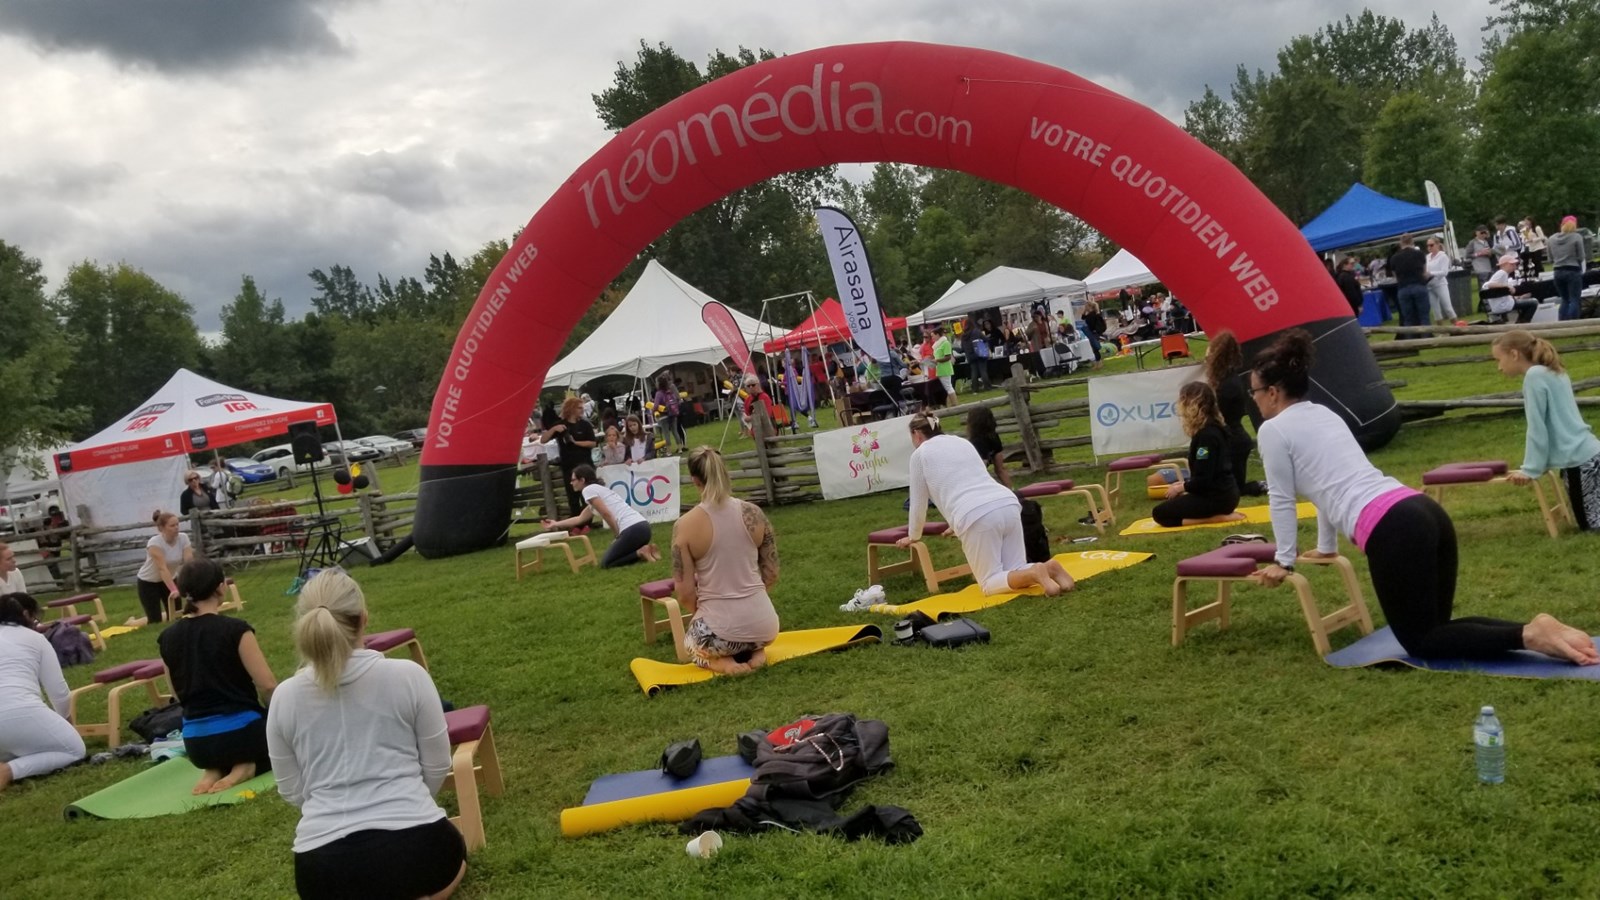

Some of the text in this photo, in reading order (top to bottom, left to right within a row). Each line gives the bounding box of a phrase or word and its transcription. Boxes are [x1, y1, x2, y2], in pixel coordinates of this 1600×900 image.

[1030, 117, 1279, 311] VOTRE QUOTIDIEN WEB
[834, 226, 872, 330] Airasana
[435, 243, 538, 448] VOTRE QUOTIDIEN WEB
[845, 311, 859, 334] yoga
[224, 402, 257, 413] IGA
[849, 451, 889, 478] Sangha
